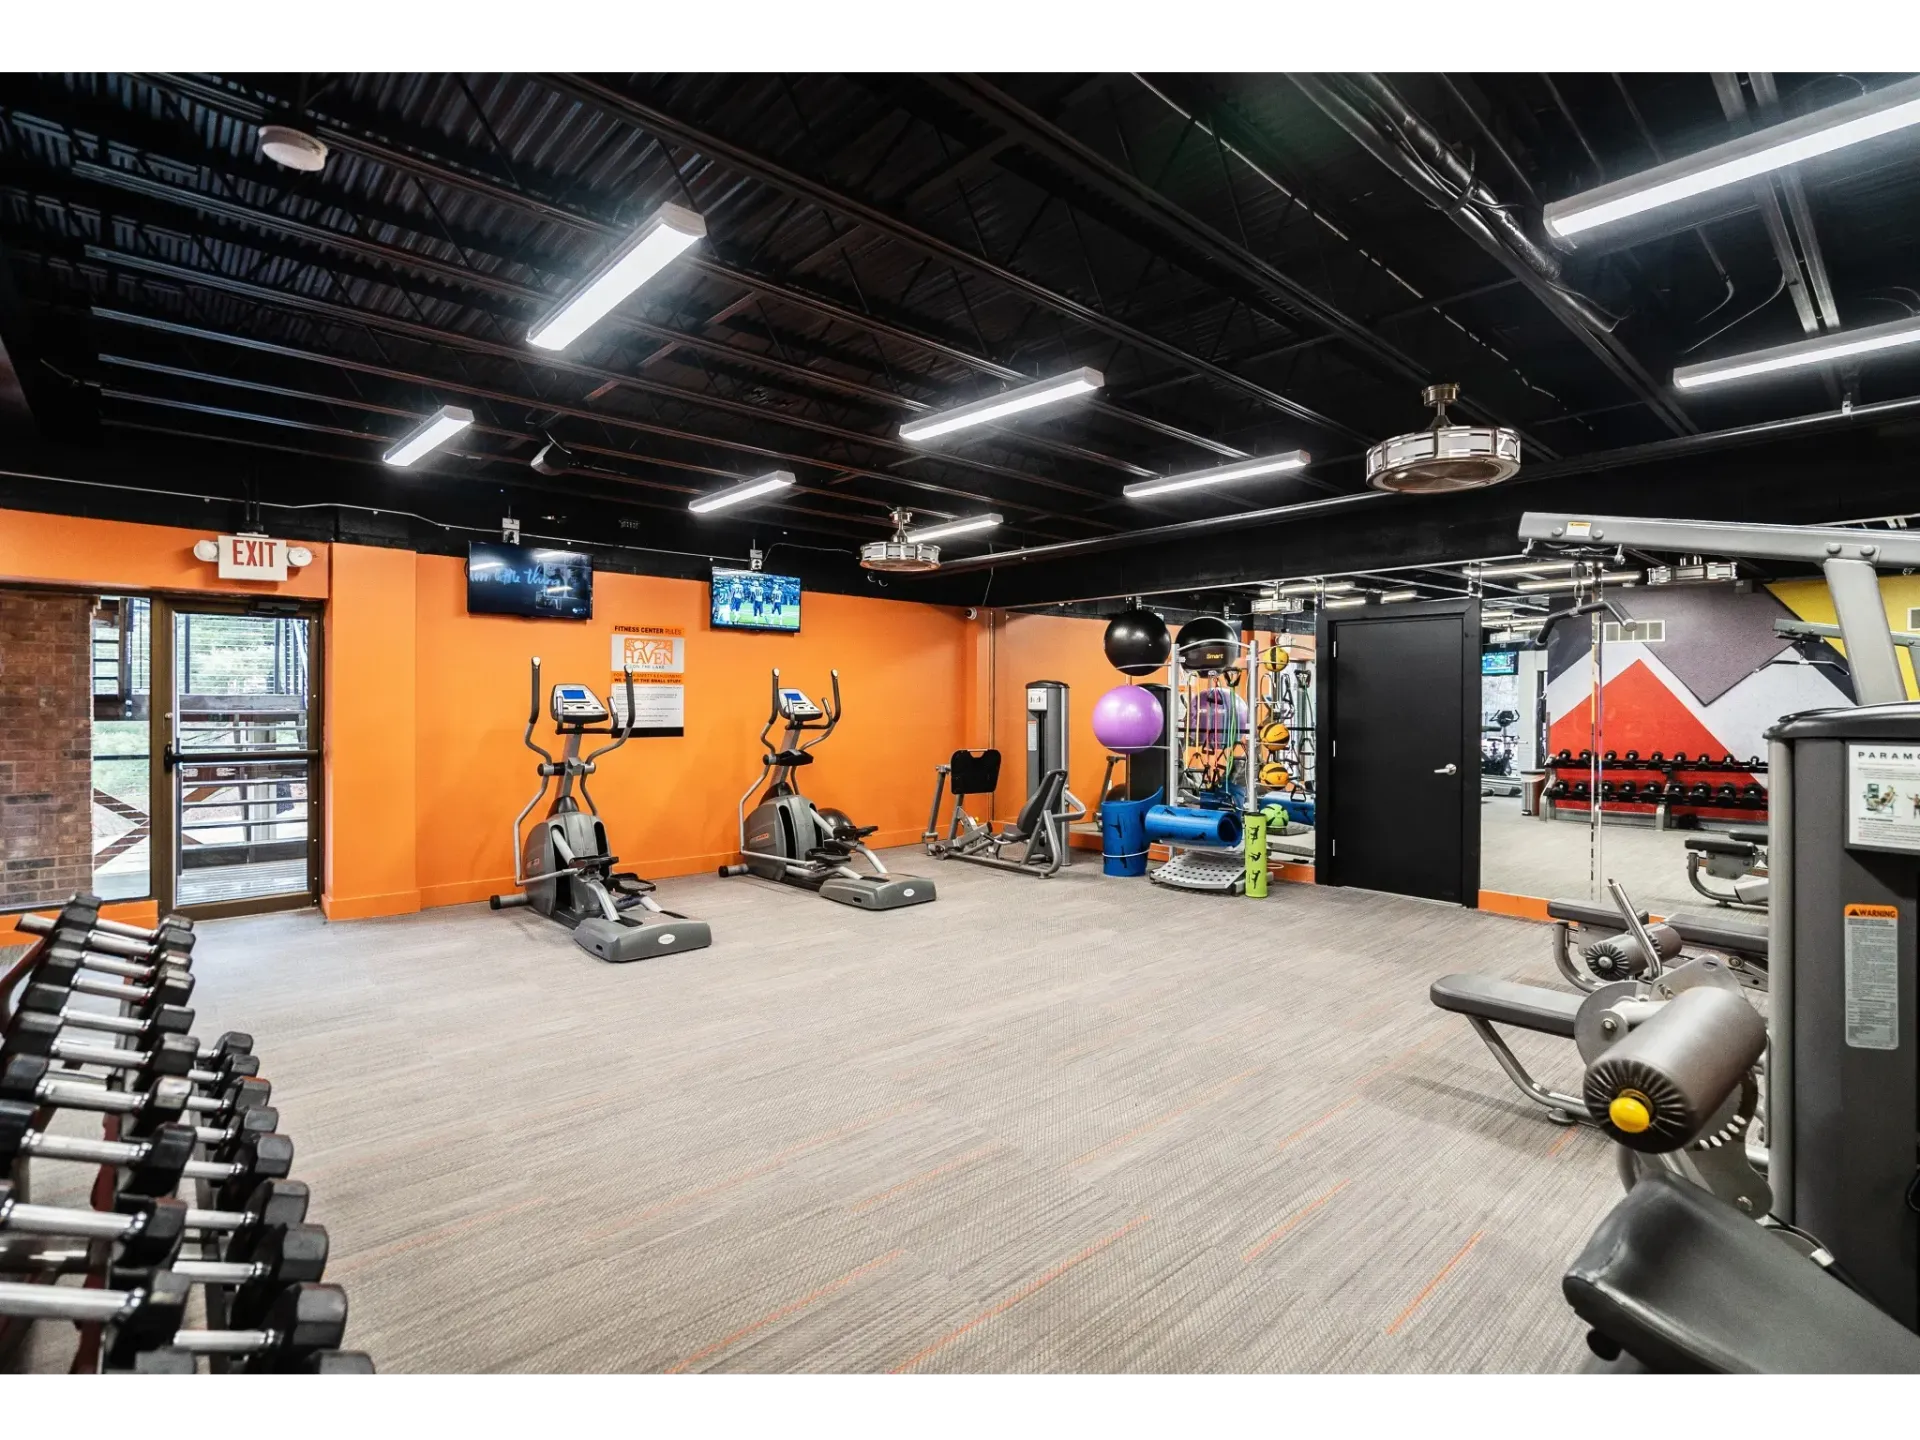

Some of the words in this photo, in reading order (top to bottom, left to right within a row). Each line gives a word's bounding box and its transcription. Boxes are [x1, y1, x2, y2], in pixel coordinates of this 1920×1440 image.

[232, 539, 277, 567] EXIT
[624, 649, 673, 664] HAVEN
[1859, 909, 1896, 918] WARNING
